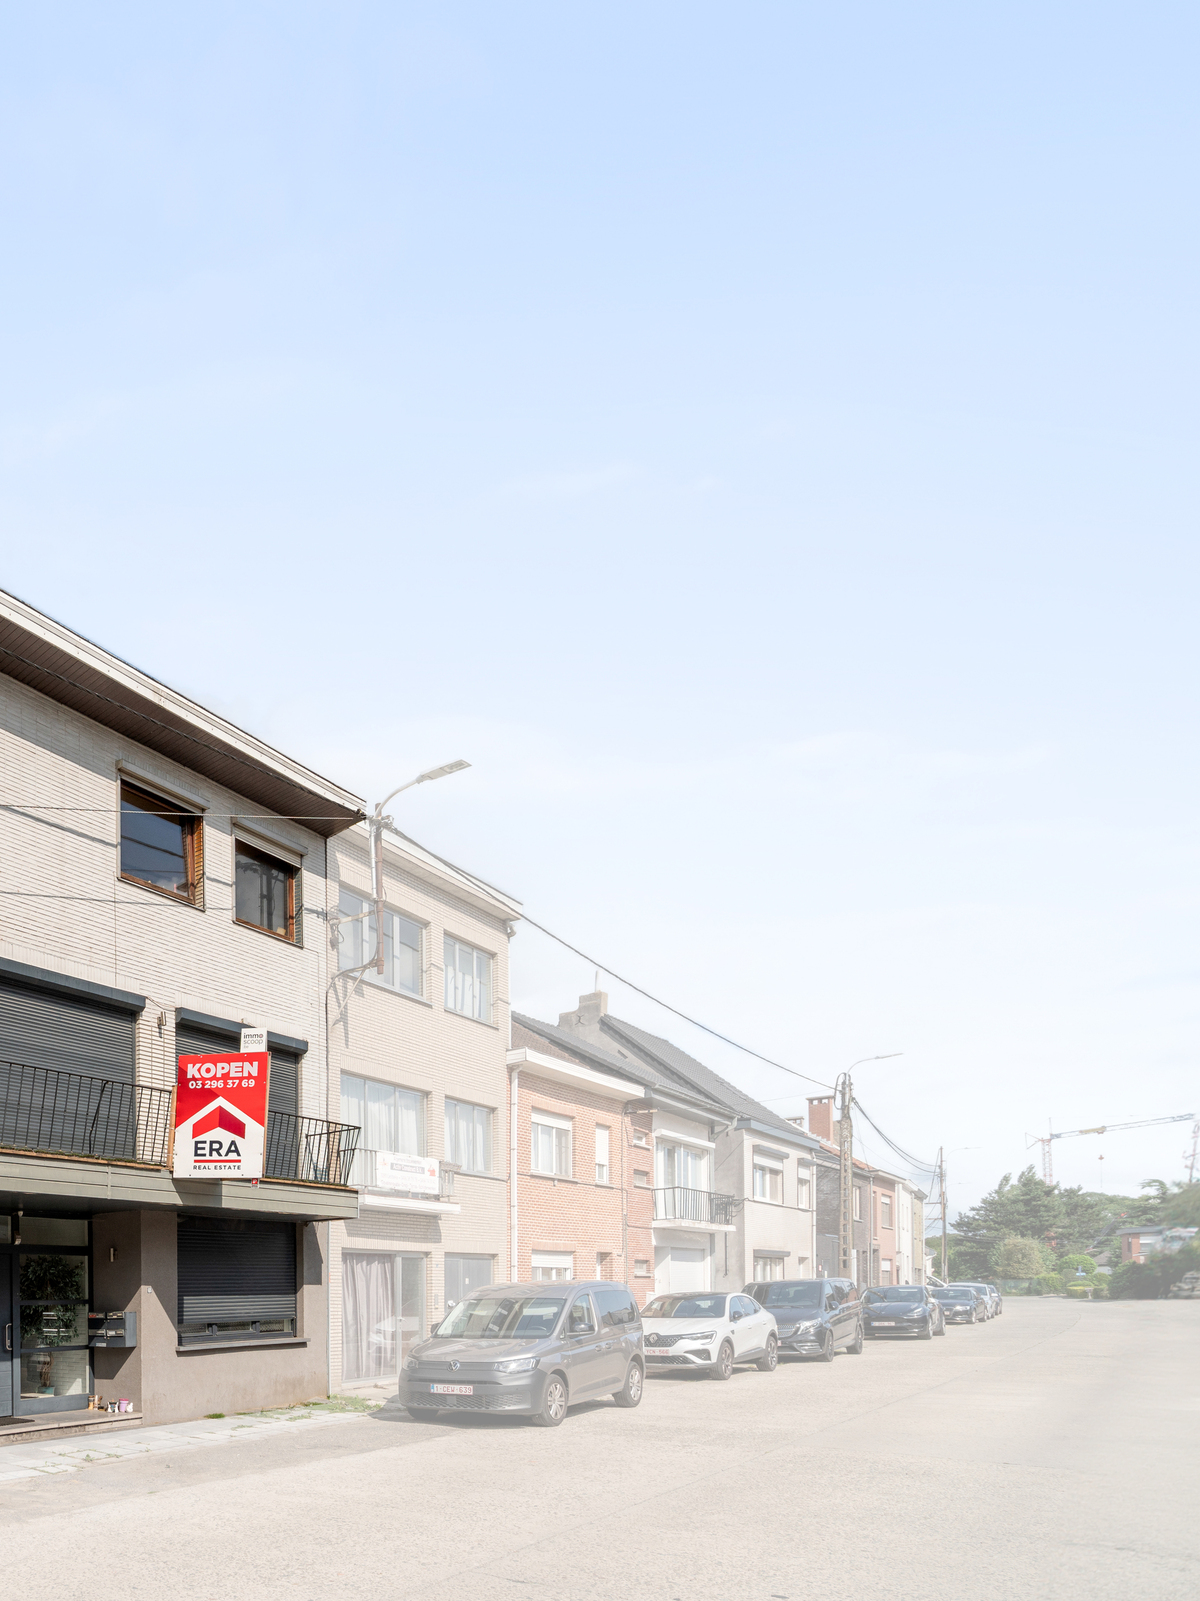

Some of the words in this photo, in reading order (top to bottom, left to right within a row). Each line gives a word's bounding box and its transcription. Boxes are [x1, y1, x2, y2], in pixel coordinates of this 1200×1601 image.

[187, 1061, 259, 1079] KOPEN
[188, 1080, 203, 1089] 03
[204, 1080, 224, 1089] 296
[226, 1079, 240, 1088] 37
[241, 1079, 256, 1088] 69
[193, 1139, 242, 1157] ERA
[435, 1385, 472, 1394] 1-CEW-639
